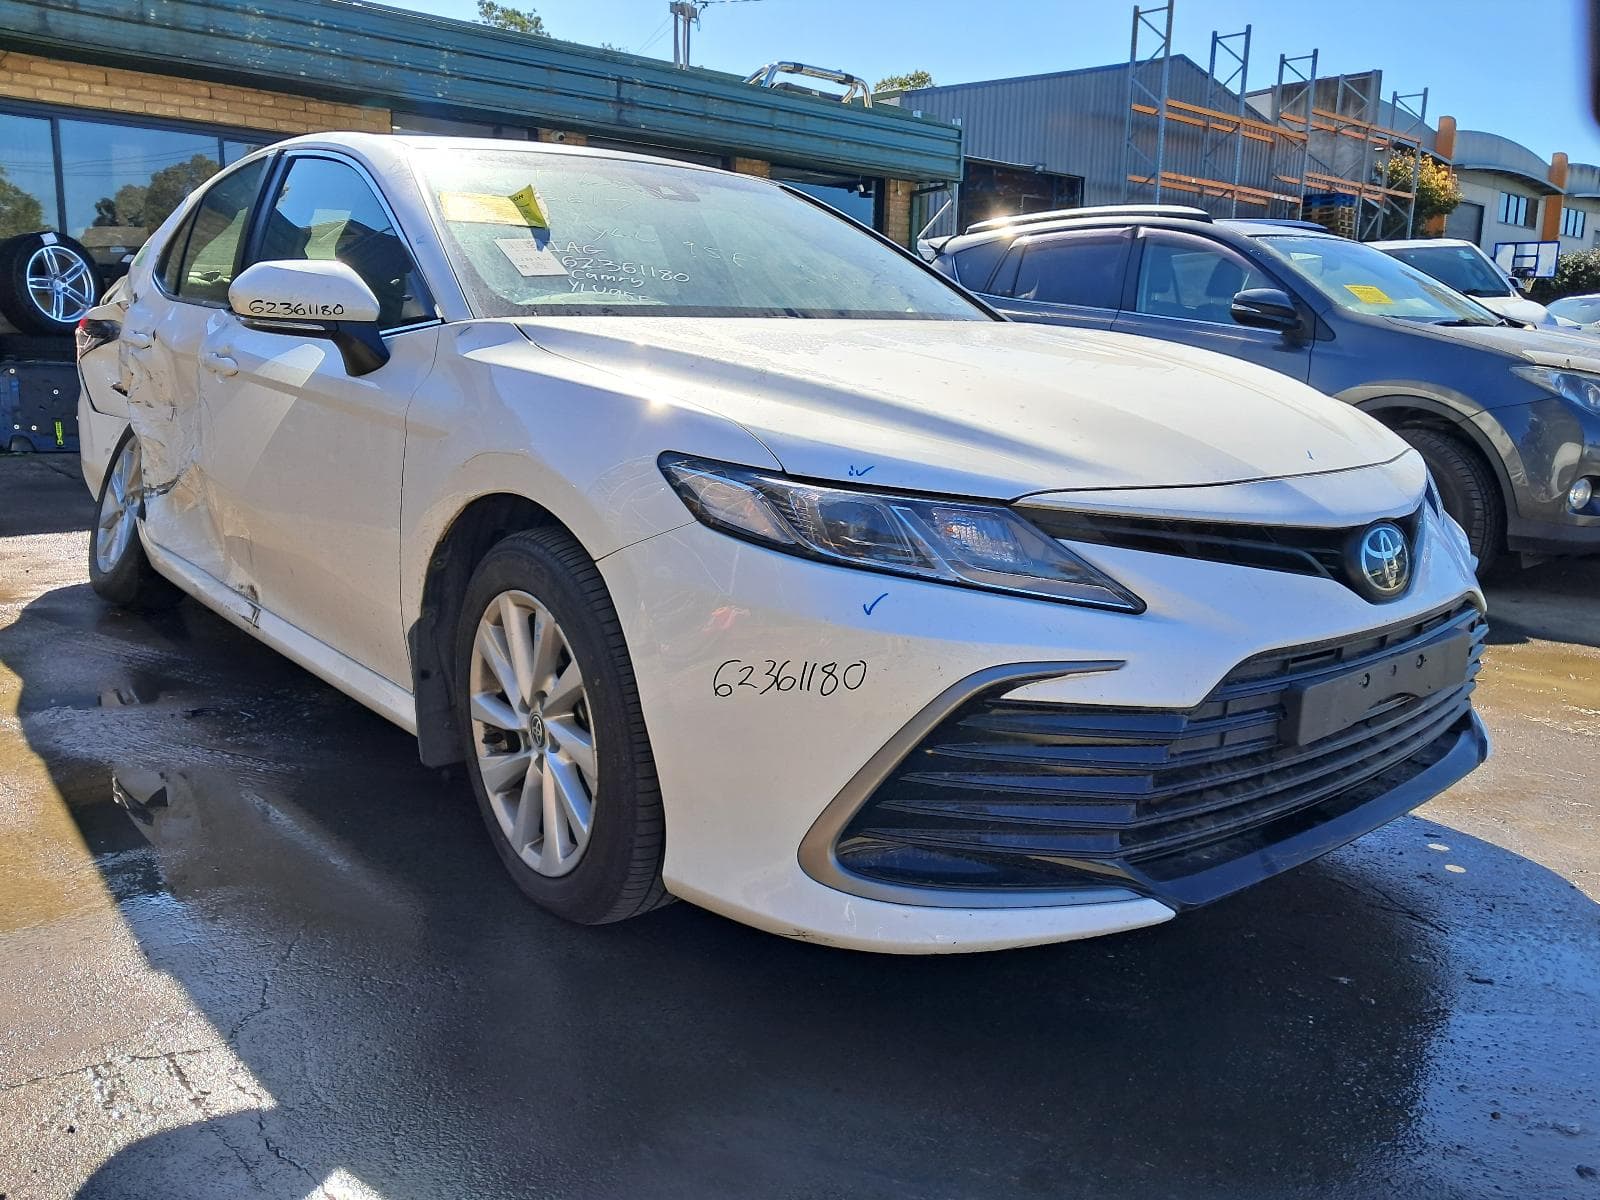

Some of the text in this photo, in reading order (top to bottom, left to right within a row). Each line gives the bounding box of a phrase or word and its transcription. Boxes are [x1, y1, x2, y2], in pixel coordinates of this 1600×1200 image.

[561, 255, 690, 283] 62361180
[248, 299, 344, 316] 62361180
[713, 659, 868, 697] 62361180
